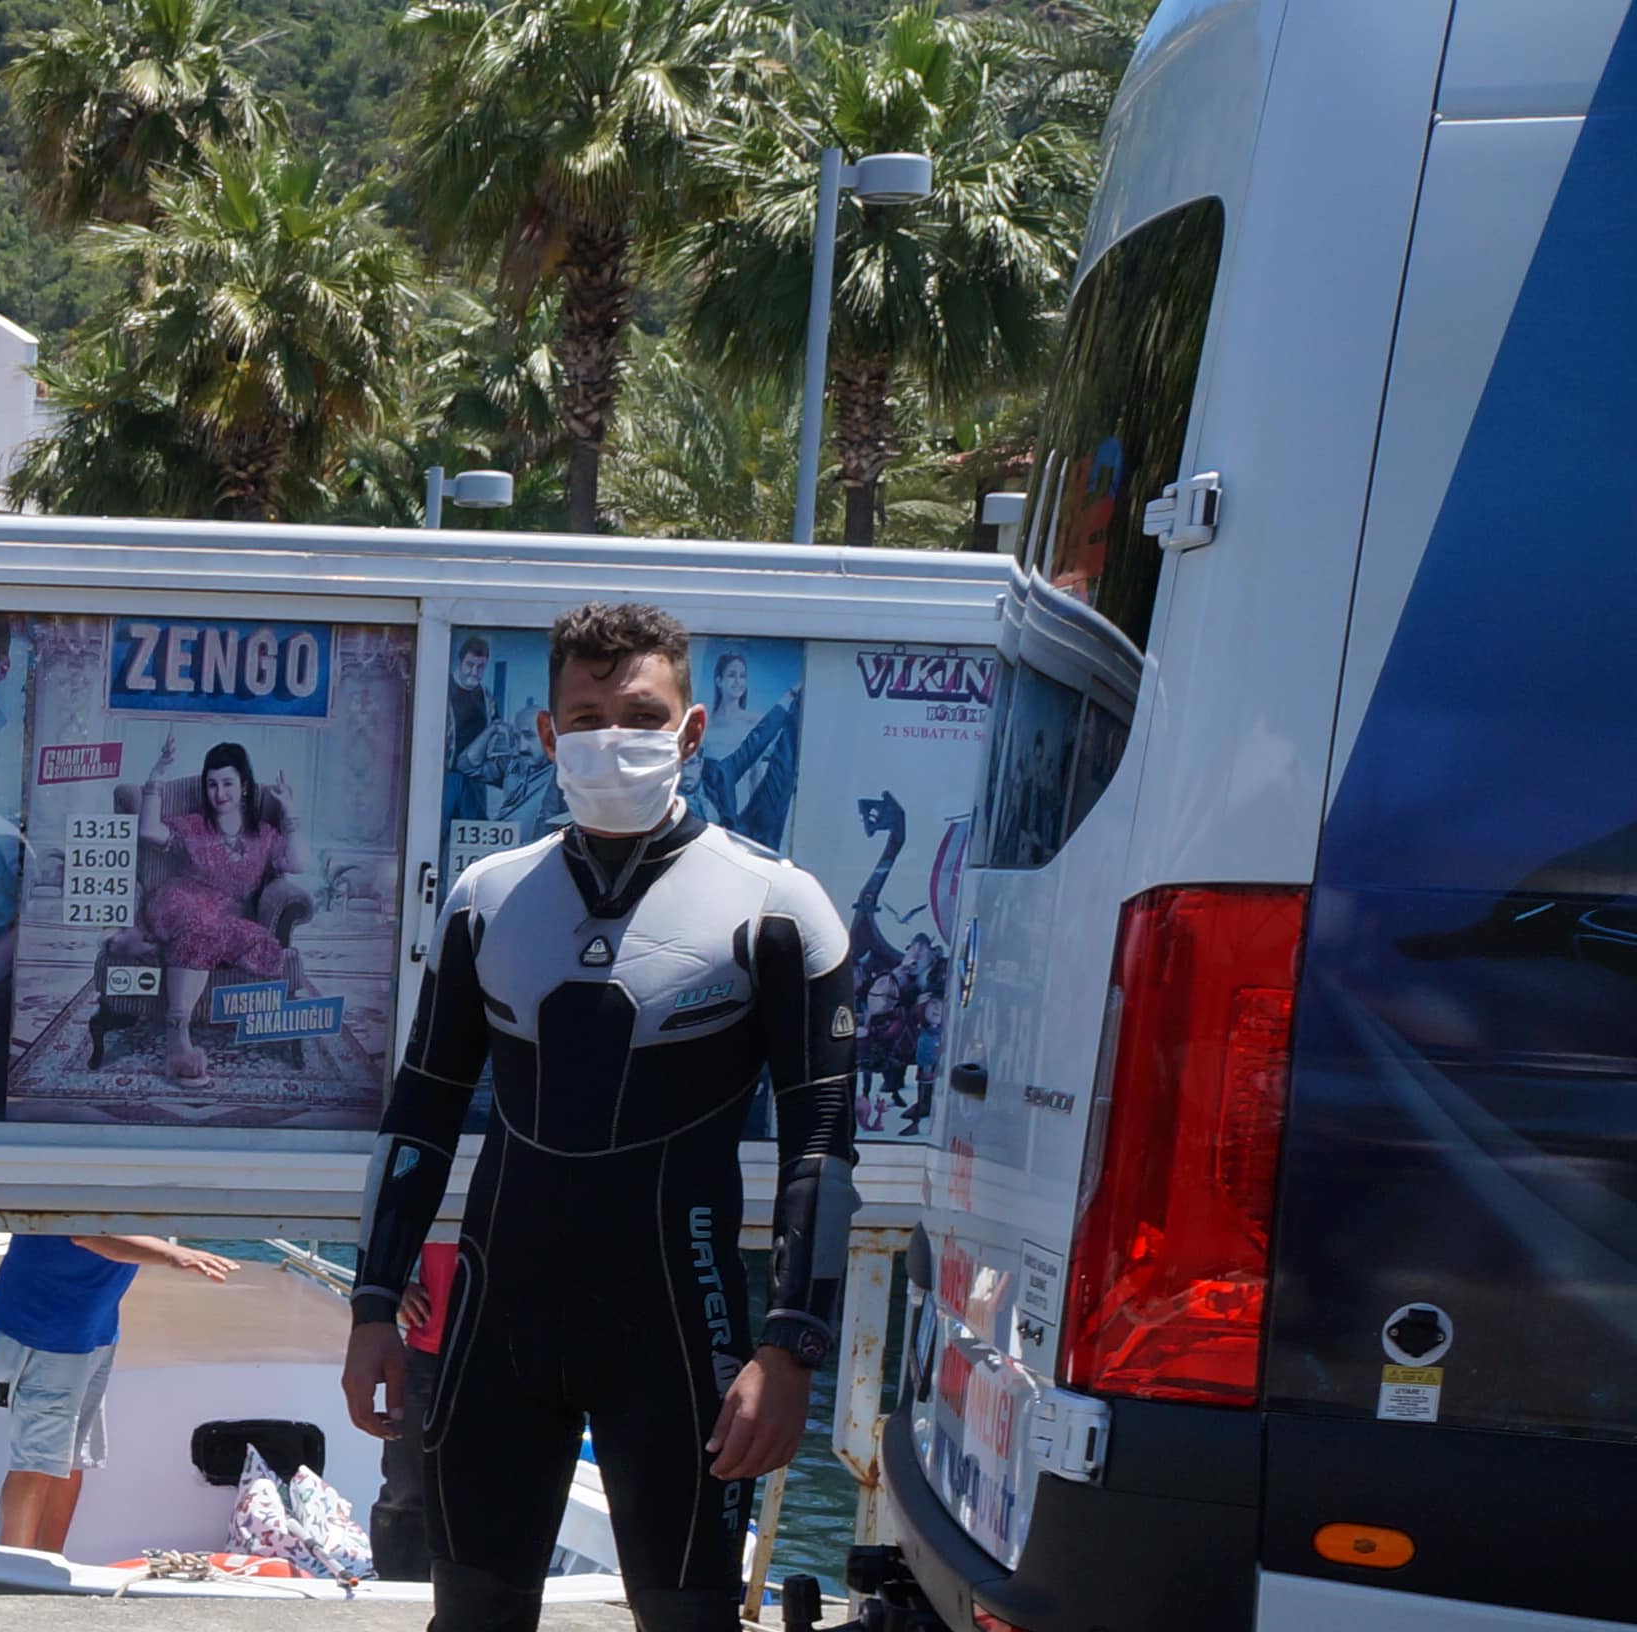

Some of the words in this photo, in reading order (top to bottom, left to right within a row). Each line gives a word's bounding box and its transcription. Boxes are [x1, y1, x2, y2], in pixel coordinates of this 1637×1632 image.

[125, 622, 320, 698] ZENGO
[73, 820, 131, 839] 13:15
[456, 825, 514, 846] 13:30
[72, 849, 130, 868] 16:00
[70, 876, 129, 896] 18:45
[68, 904, 128, 923] 21:30
[222, 986, 283, 1016] YASEMİN
[245, 1004, 335, 1036] SAKALLIOĞLU
[688, 1206, 734, 1347] WATER
